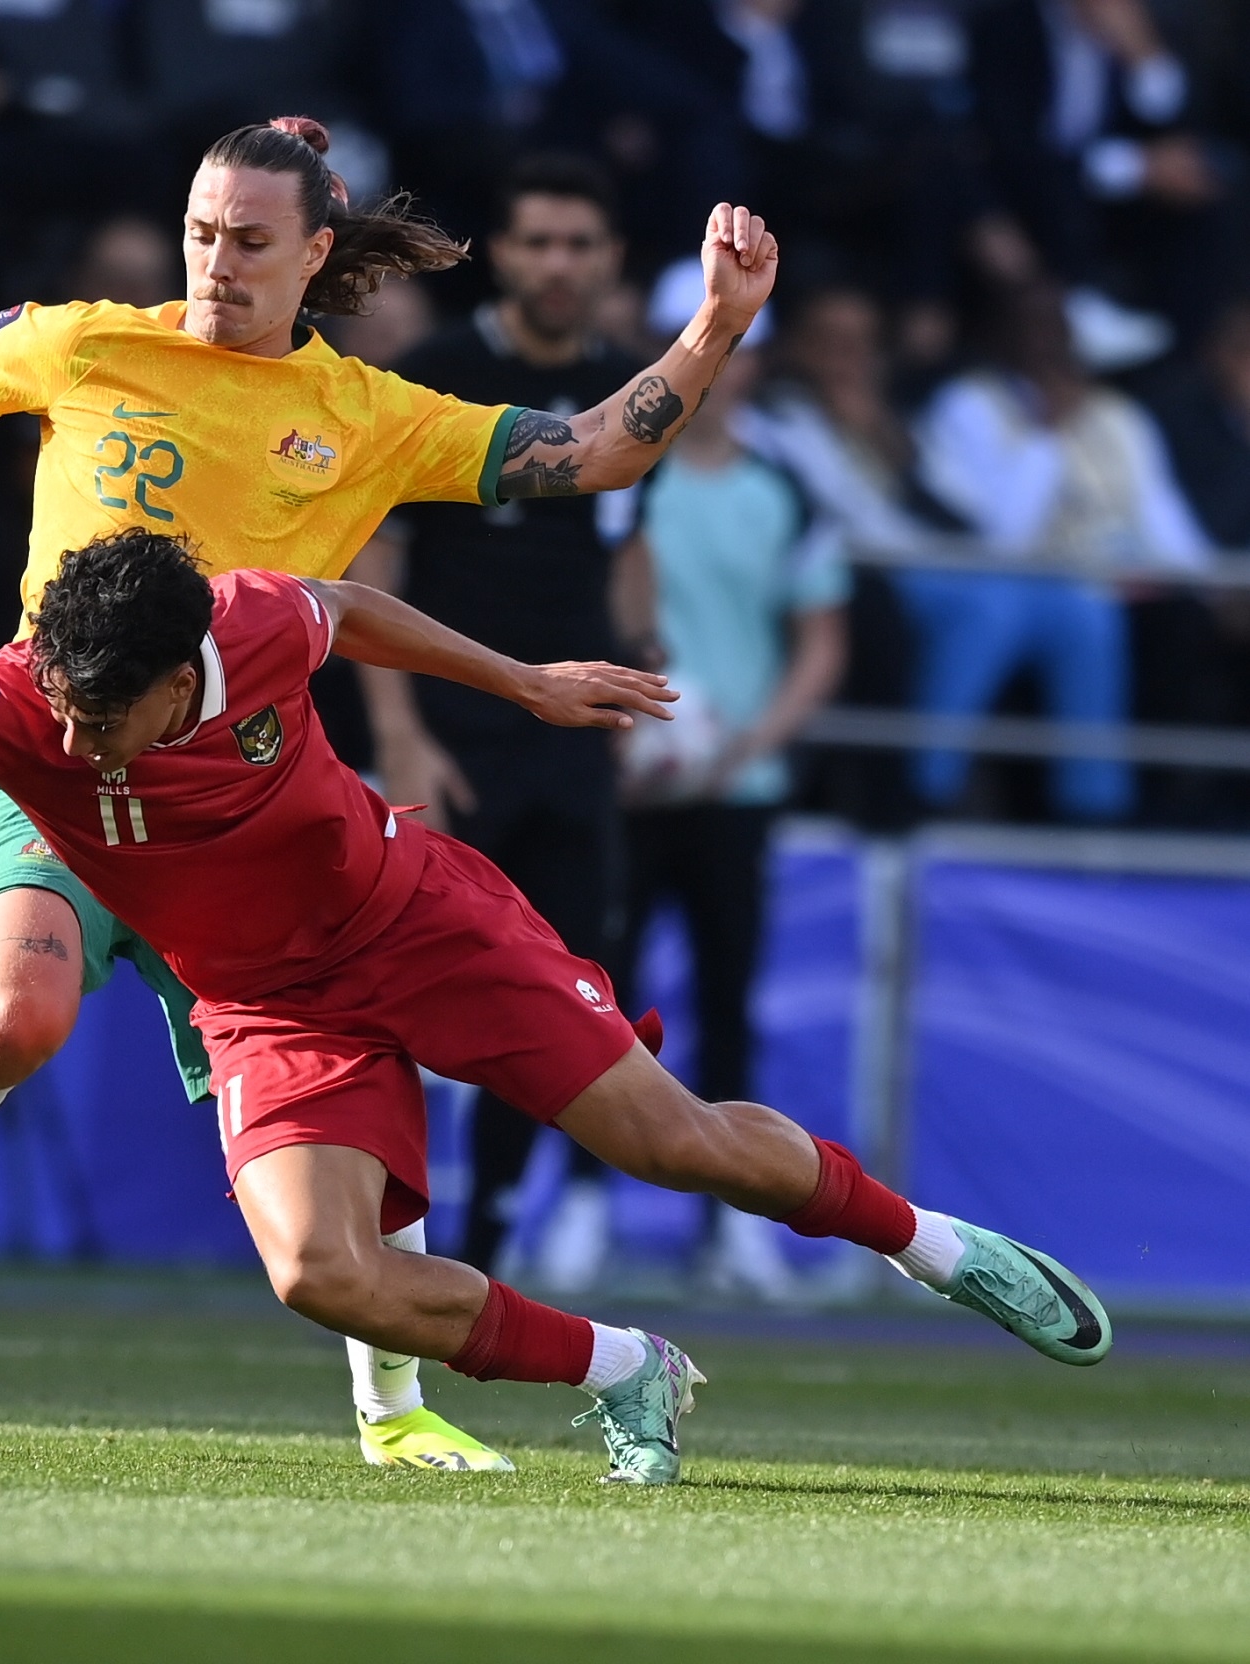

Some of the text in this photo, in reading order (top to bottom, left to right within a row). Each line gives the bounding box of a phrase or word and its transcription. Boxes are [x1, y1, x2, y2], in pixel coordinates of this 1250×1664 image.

[95, 431, 184, 522] 22
[279, 457, 326, 474] AUSTRALIA
[96, 785, 130, 795] MILLS
[99, 795, 148, 846] 11
